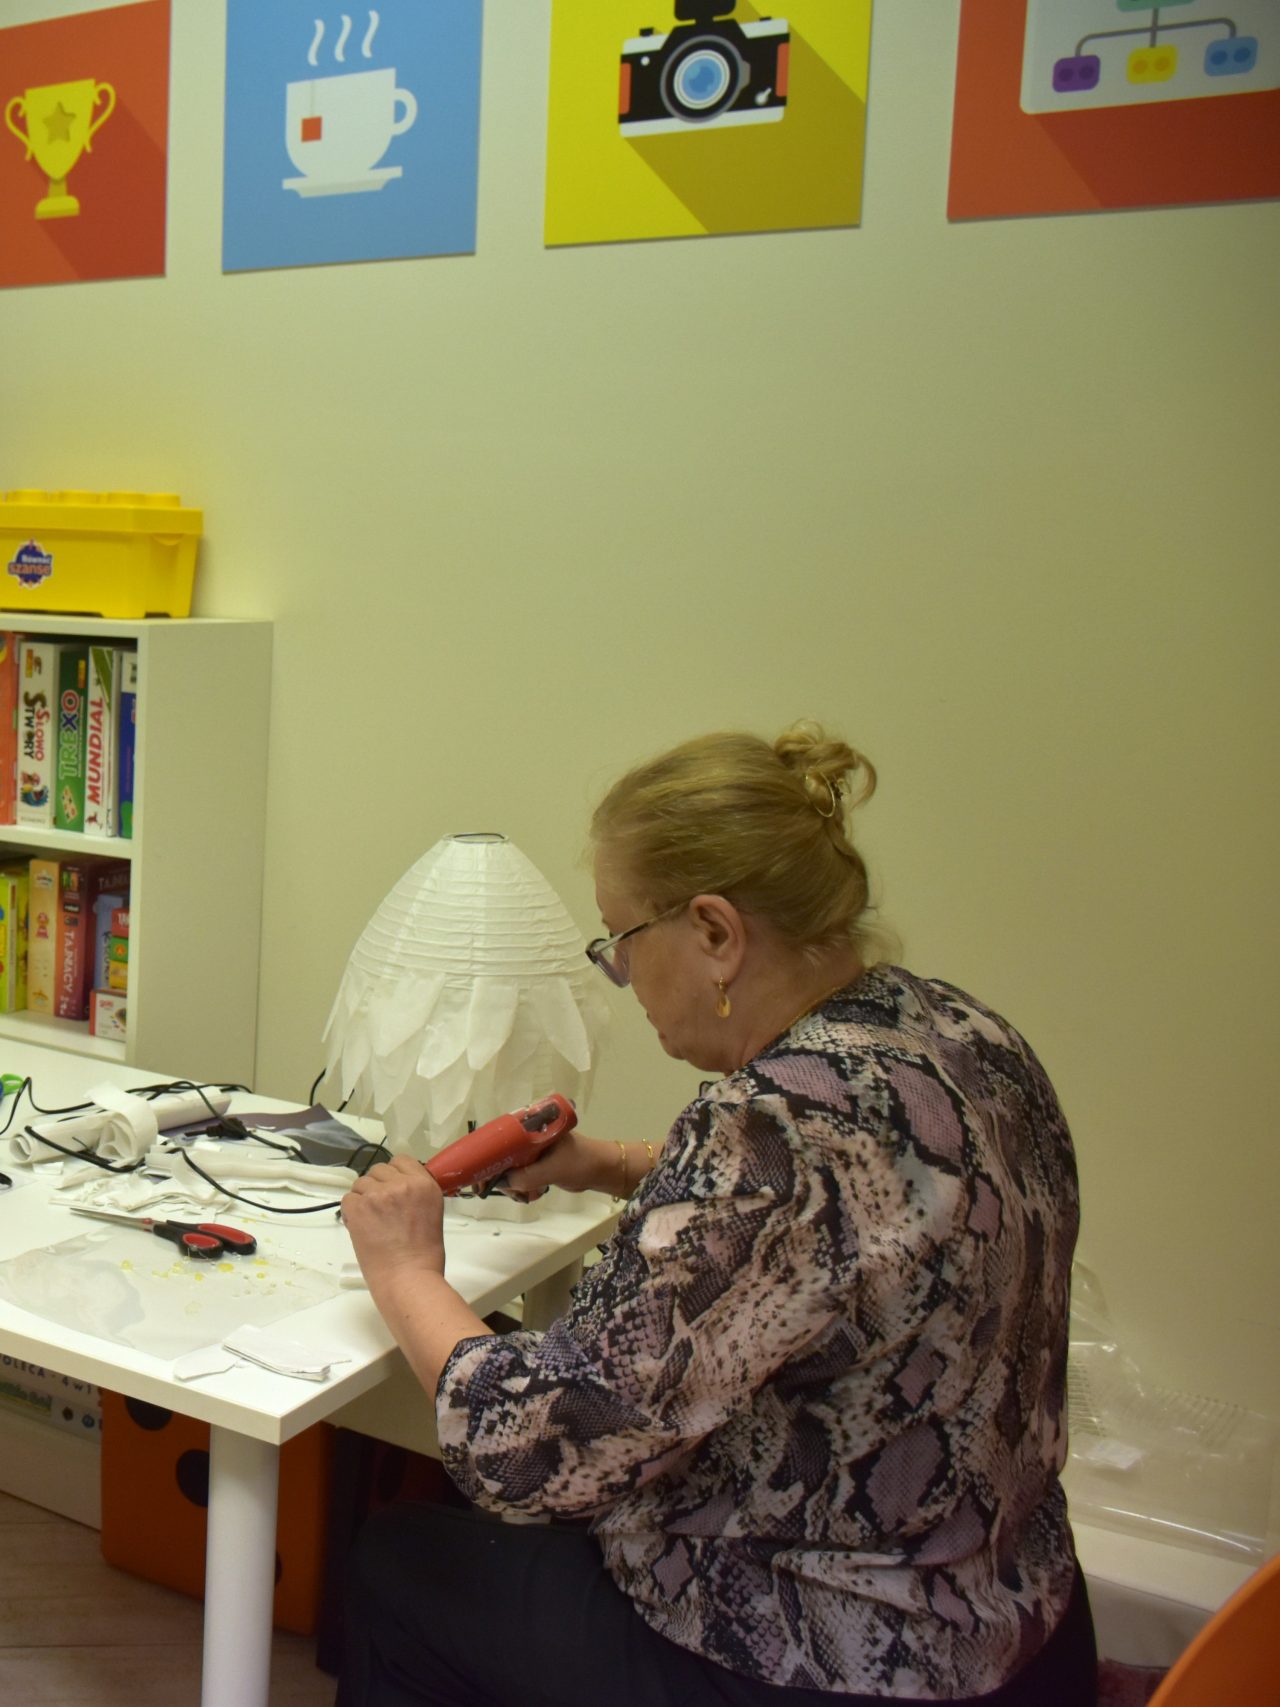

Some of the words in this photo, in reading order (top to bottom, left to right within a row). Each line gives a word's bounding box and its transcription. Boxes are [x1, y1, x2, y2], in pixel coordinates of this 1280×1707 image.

[59, 689, 80, 779] TREXO
[87, 697, 104, 806] MUNDIAL
[63, 930, 75, 993] TAJNIACY
